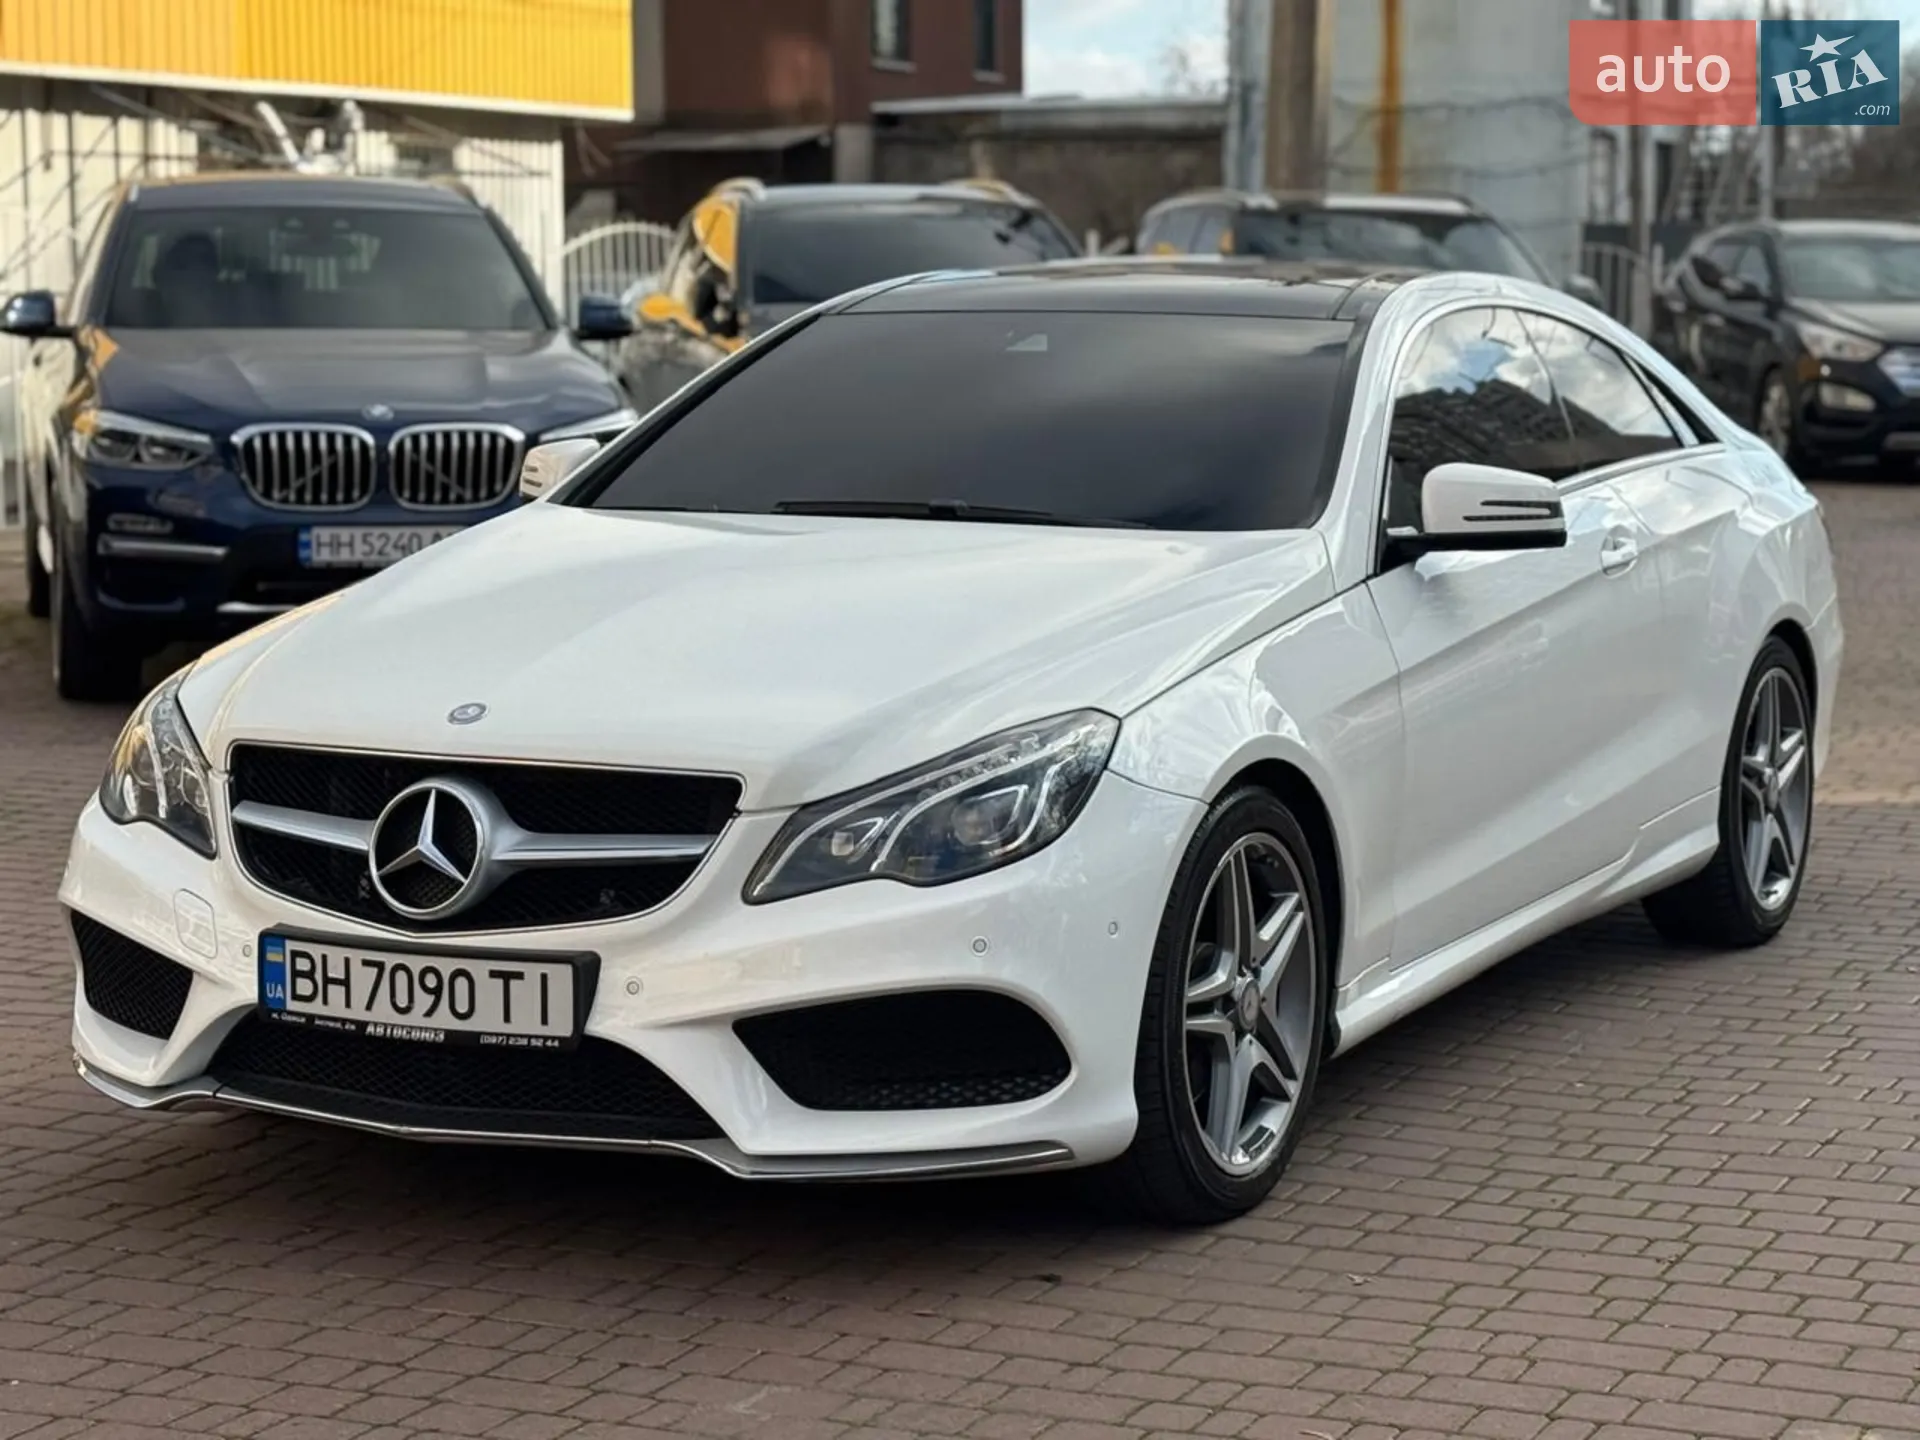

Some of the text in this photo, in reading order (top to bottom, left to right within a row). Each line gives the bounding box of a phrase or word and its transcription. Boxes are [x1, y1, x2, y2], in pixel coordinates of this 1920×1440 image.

[266, 983, 285, 999] UA
[290, 949, 548, 1026] BH 7090 TI
